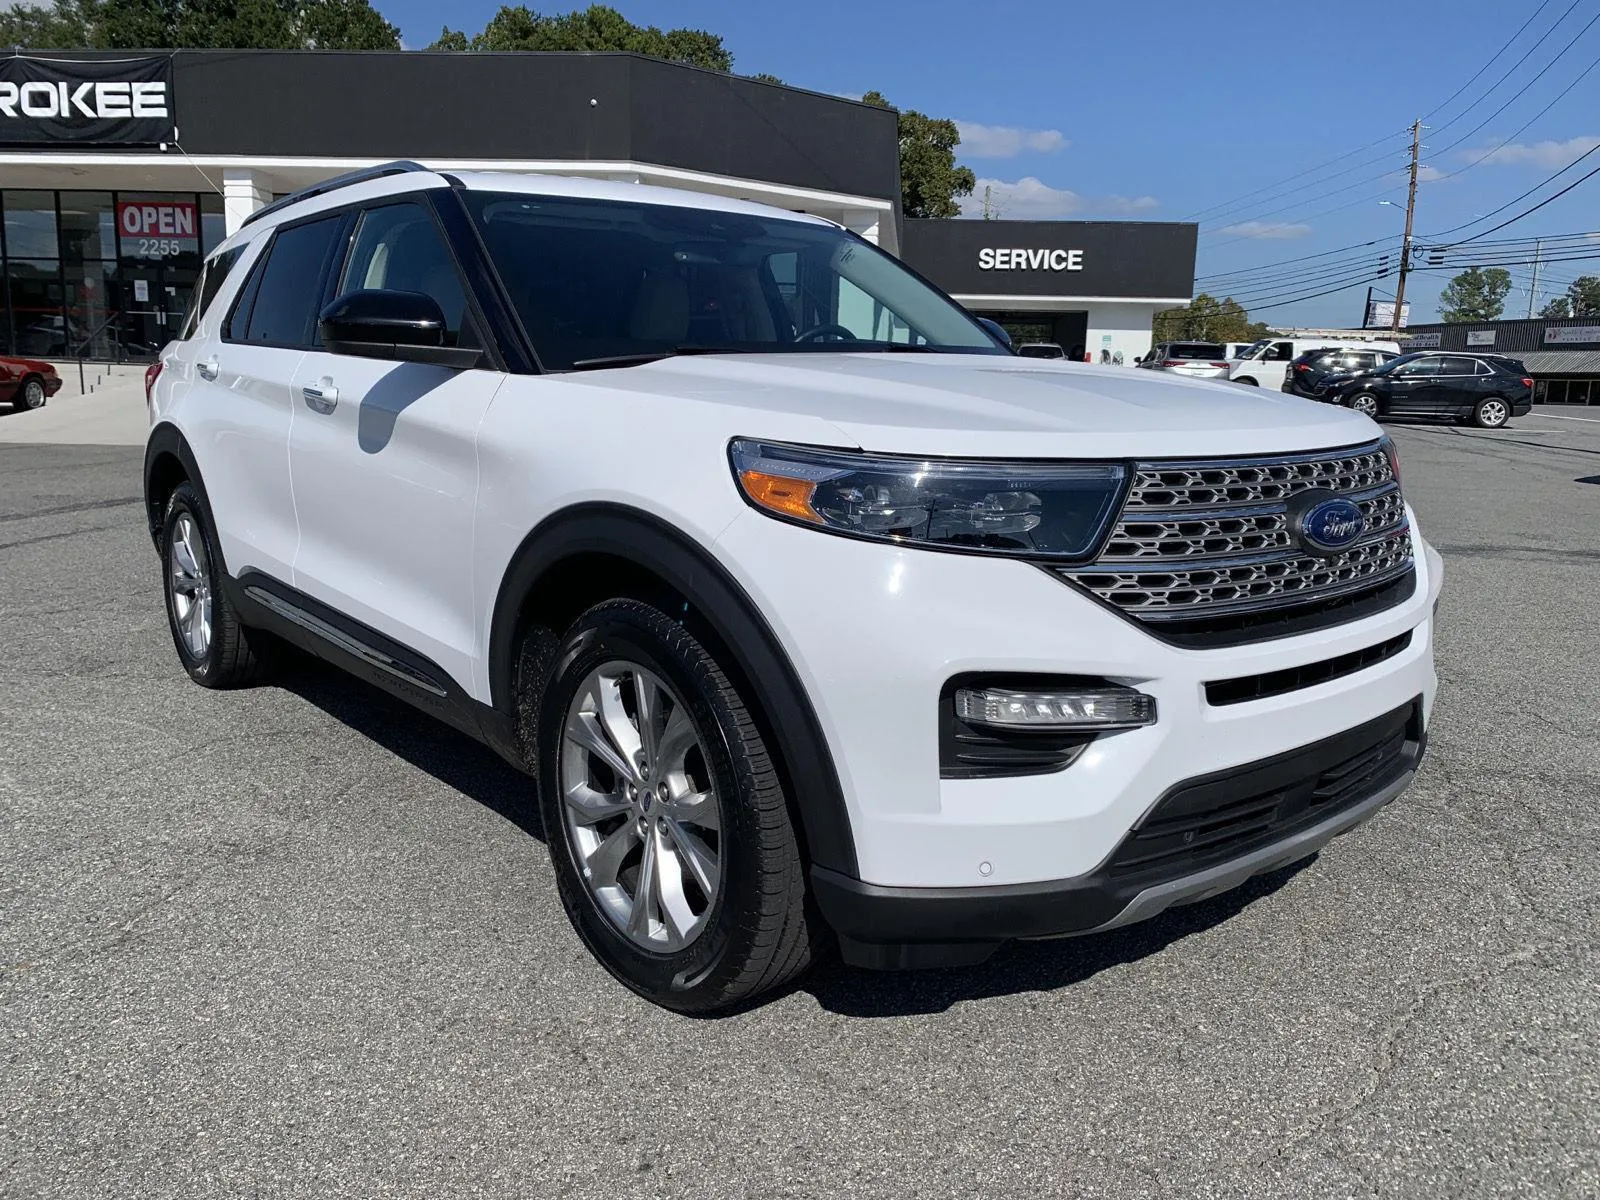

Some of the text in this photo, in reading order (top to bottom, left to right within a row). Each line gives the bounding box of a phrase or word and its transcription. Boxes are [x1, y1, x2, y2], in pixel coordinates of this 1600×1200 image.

[0, 81, 168, 118] ROKEE
[123, 206, 193, 235] OPEN
[139, 239, 180, 256] 2255
[978, 248, 1084, 271] SERVICE
[1323, 510, 1357, 539] Ford
